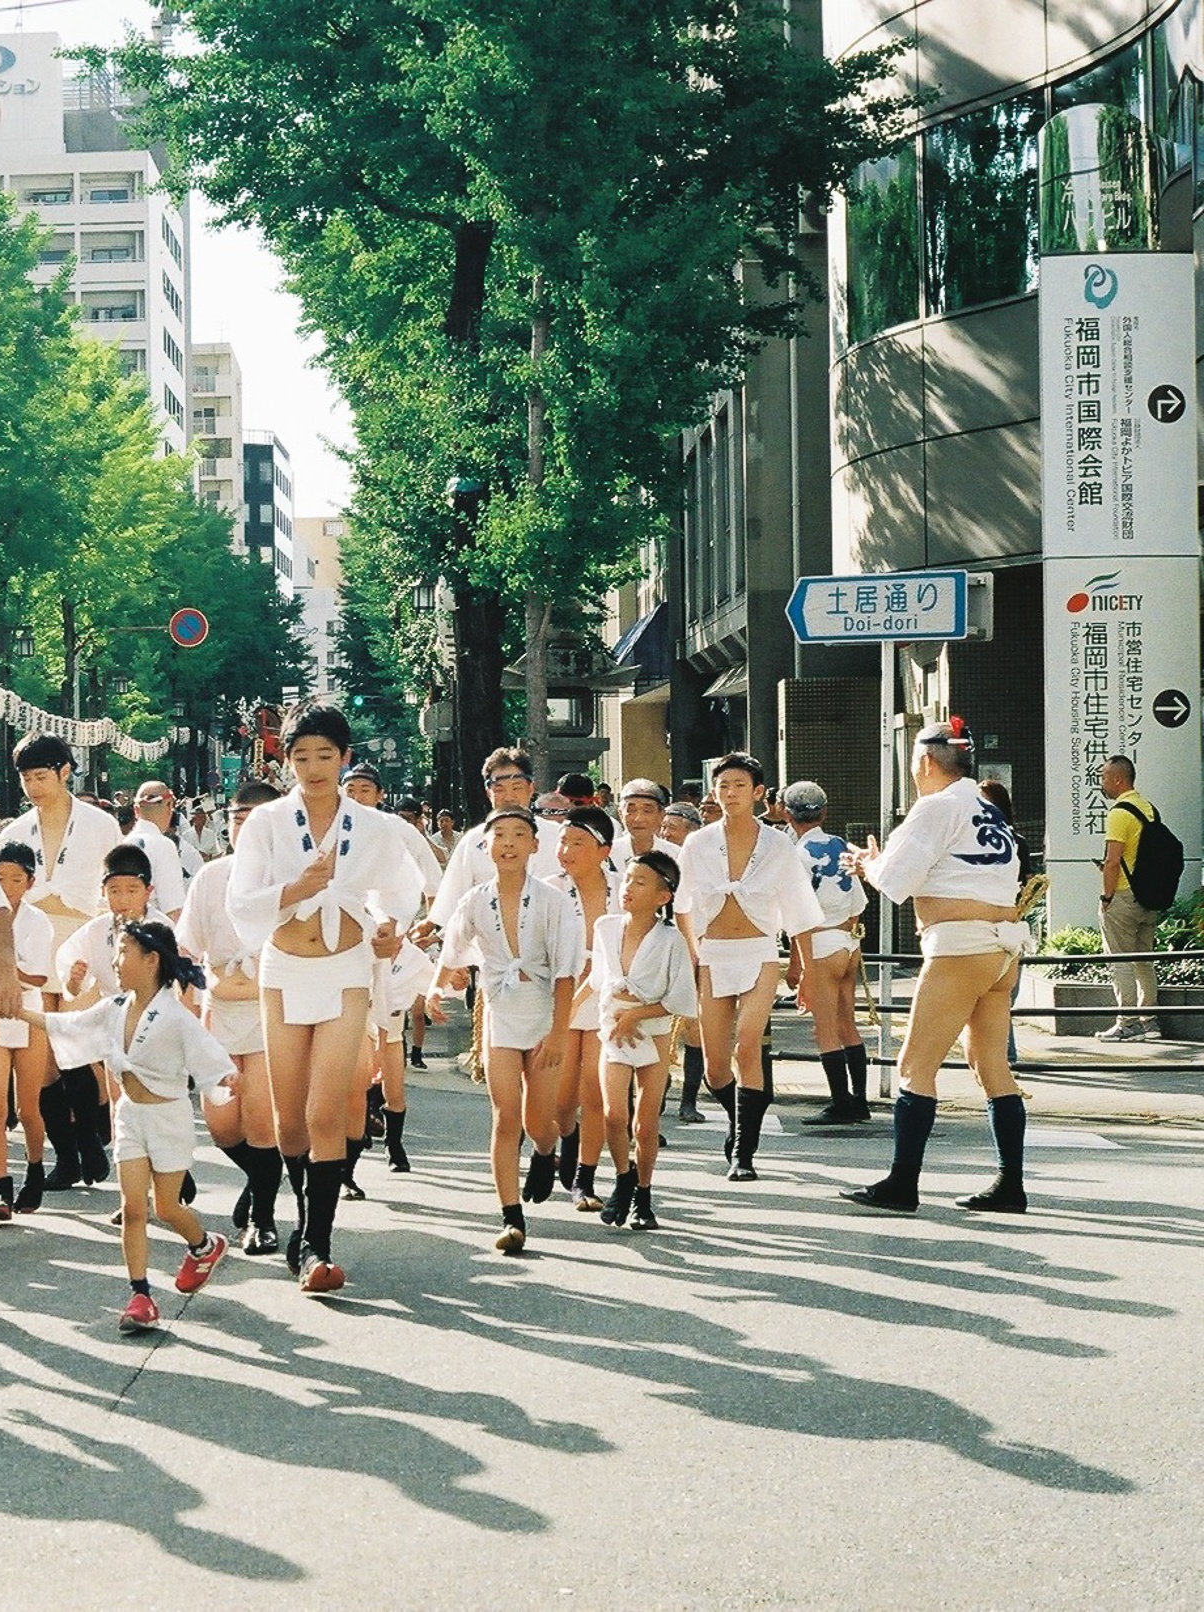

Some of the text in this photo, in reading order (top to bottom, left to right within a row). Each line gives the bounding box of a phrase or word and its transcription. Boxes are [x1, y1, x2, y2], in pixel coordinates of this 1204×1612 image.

[1064, 317, 1076, 532] Fukuoka City International Center
[1075, 317, 1103, 506] 福岡市国際会館
[826, 583, 938, 615] 土居通り
[843, 614, 918, 631] Doi-dori
[1069, 621, 1082, 836] Fukuoka City Housing Supply Corporation
[1082, 622, 1109, 835] 福岡市住宅供給公社
[1119, 724, 1127, 755] Cente
[1126, 621, 1142, 764] 市営住宅センター
